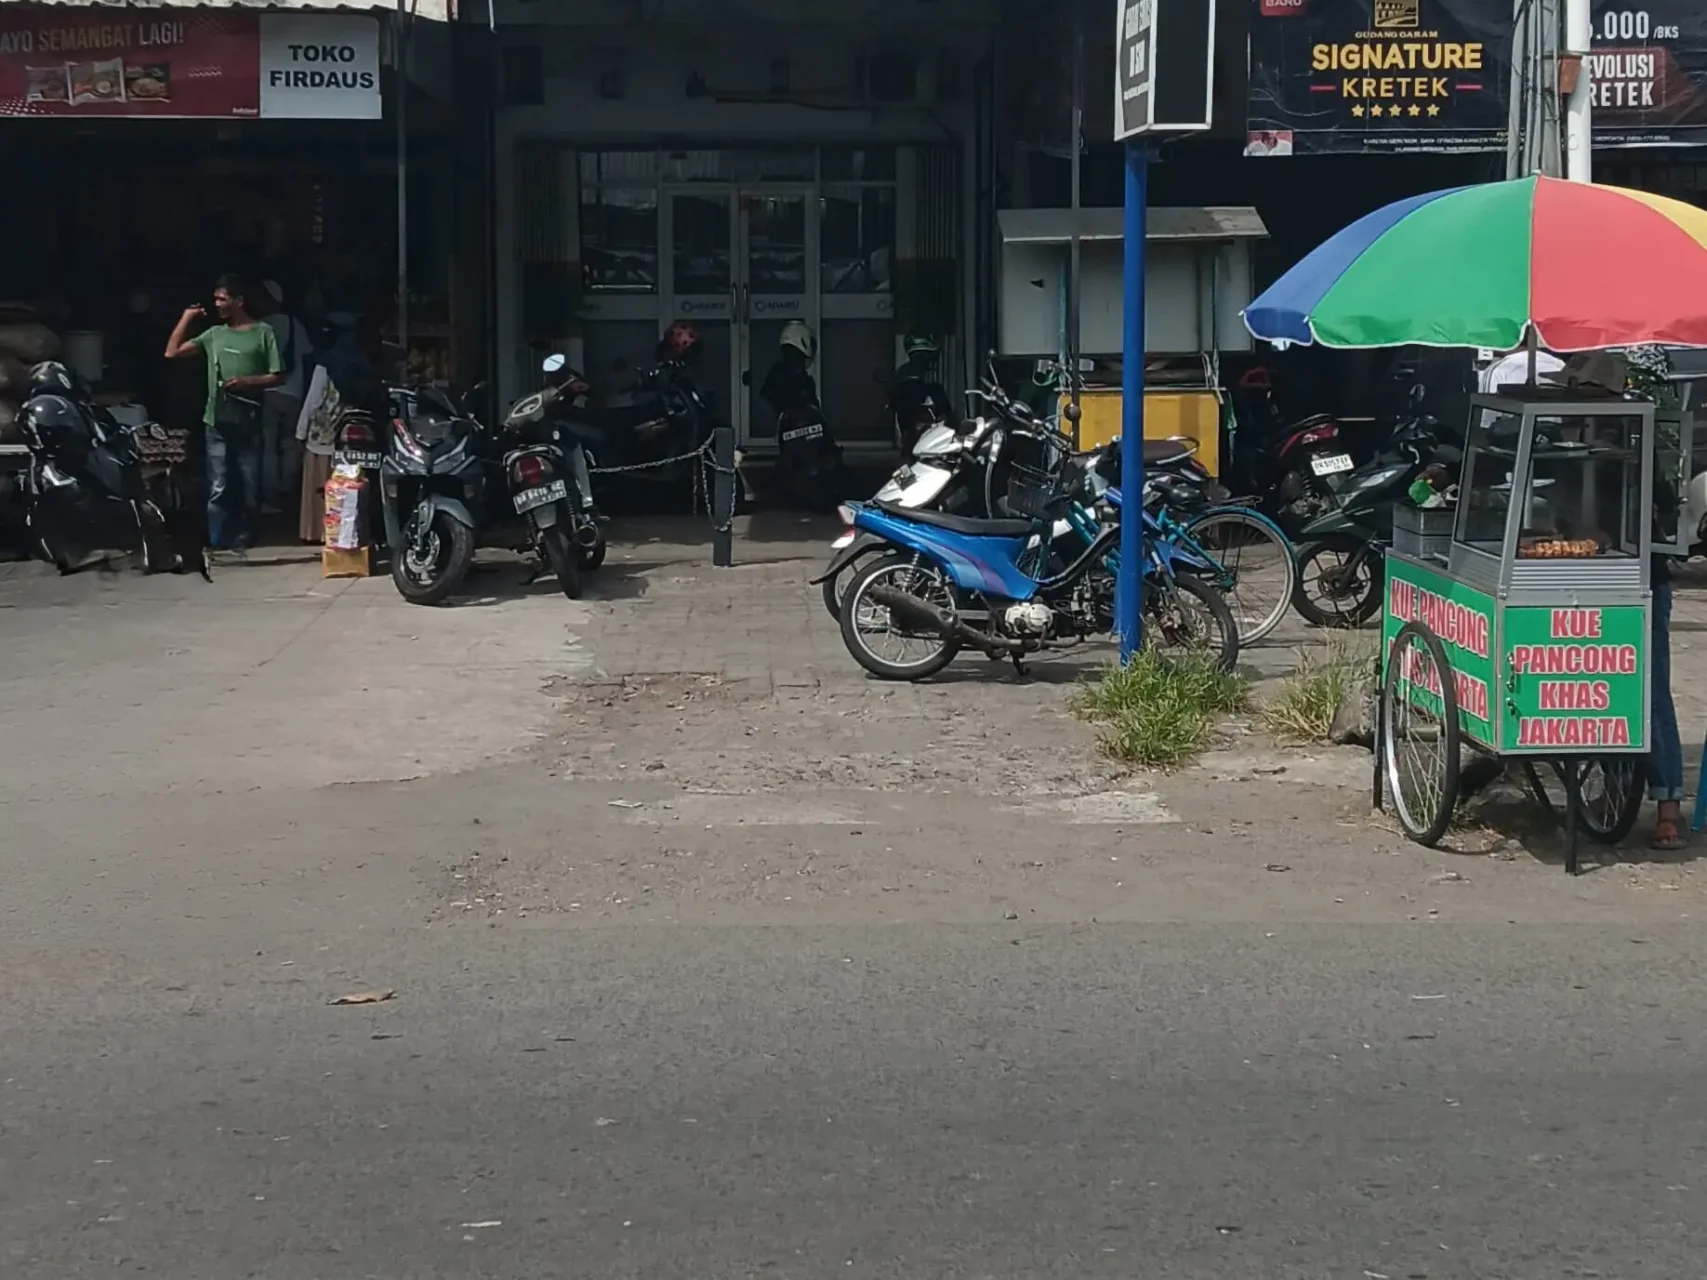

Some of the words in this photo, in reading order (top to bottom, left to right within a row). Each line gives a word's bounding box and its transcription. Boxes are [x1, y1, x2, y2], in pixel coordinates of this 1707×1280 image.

[0, 30, 33, 53] AYO
[38, 24, 133, 52] SEMANGAT
[139, 22, 184, 46] LAGI!
[1355, 31, 1398, 39] GUDANG
[1589, 11, 1649, 39] .000
[1653, 25, 1680, 39] /BKS
[288, 45, 356, 63] TOKO
[1312, 43, 1483, 70] SIGNATURE
[269, 70, 374, 89] FIRDAUS
[1342, 77, 1449, 98] KRETEK
[1589, 82, 1655, 107] RETEK
[1390, 577, 1418, 622] KUE
[1419, 587, 1488, 658] PANCONG
[1552, 608, 1602, 638] KUE
[1514, 645, 1637, 674] PANCONG
[1539, 681, 1609, 710] KHAS
[1518, 717, 1630, 746] JAKARTA
